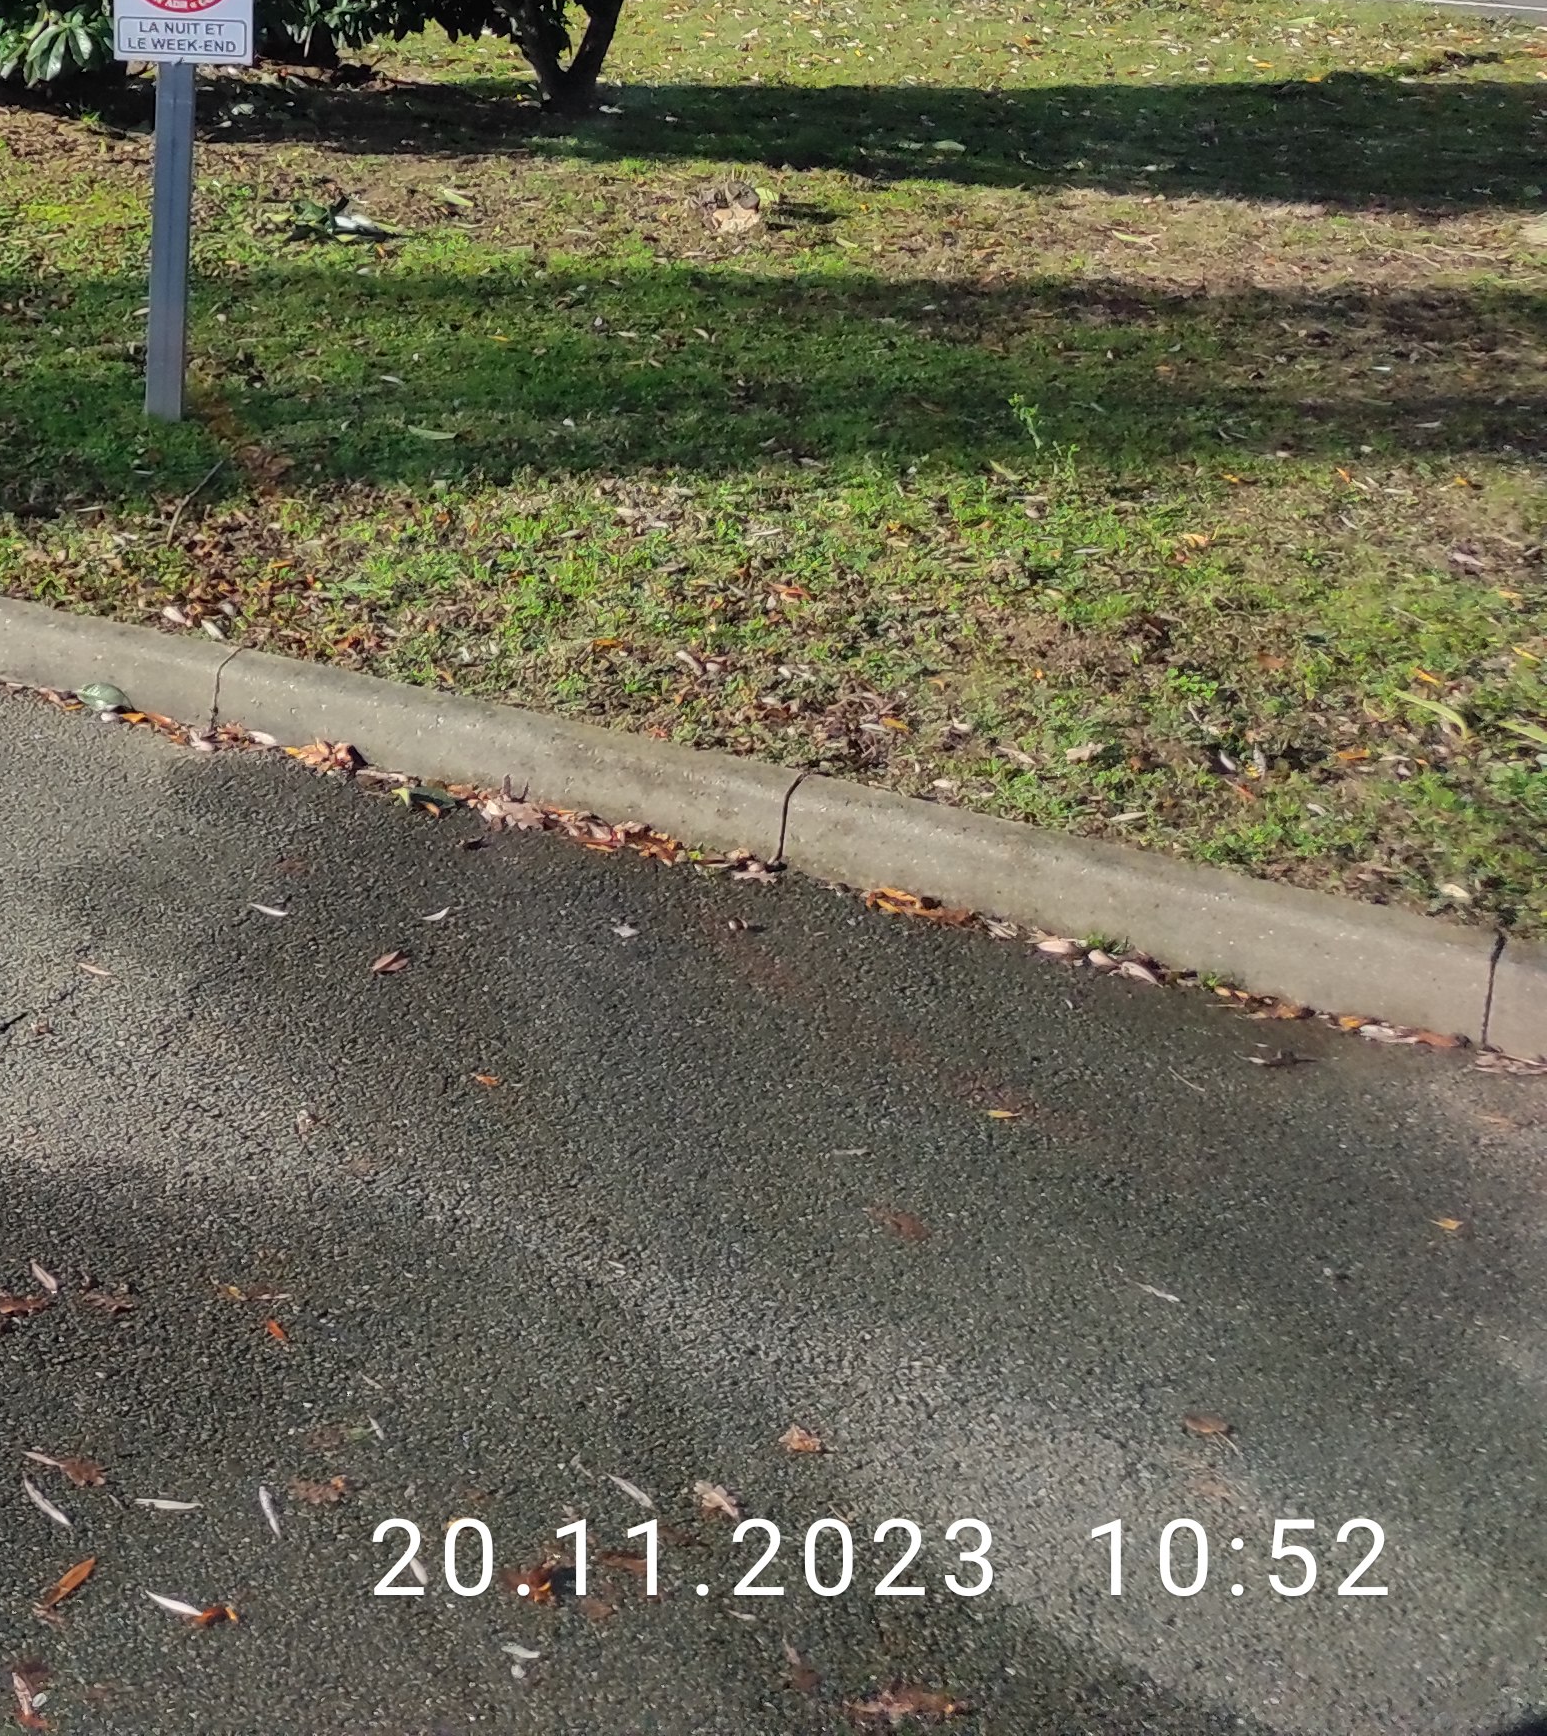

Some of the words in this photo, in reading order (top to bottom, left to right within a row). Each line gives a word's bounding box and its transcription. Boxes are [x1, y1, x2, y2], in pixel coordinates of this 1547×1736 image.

[139, 21, 159, 33] LA
[164, 21, 201, 34] NUIT
[205, 23, 225, 36] ET
[128, 37, 147, 49] LE
[151, 38, 237, 52] WEEK-END
